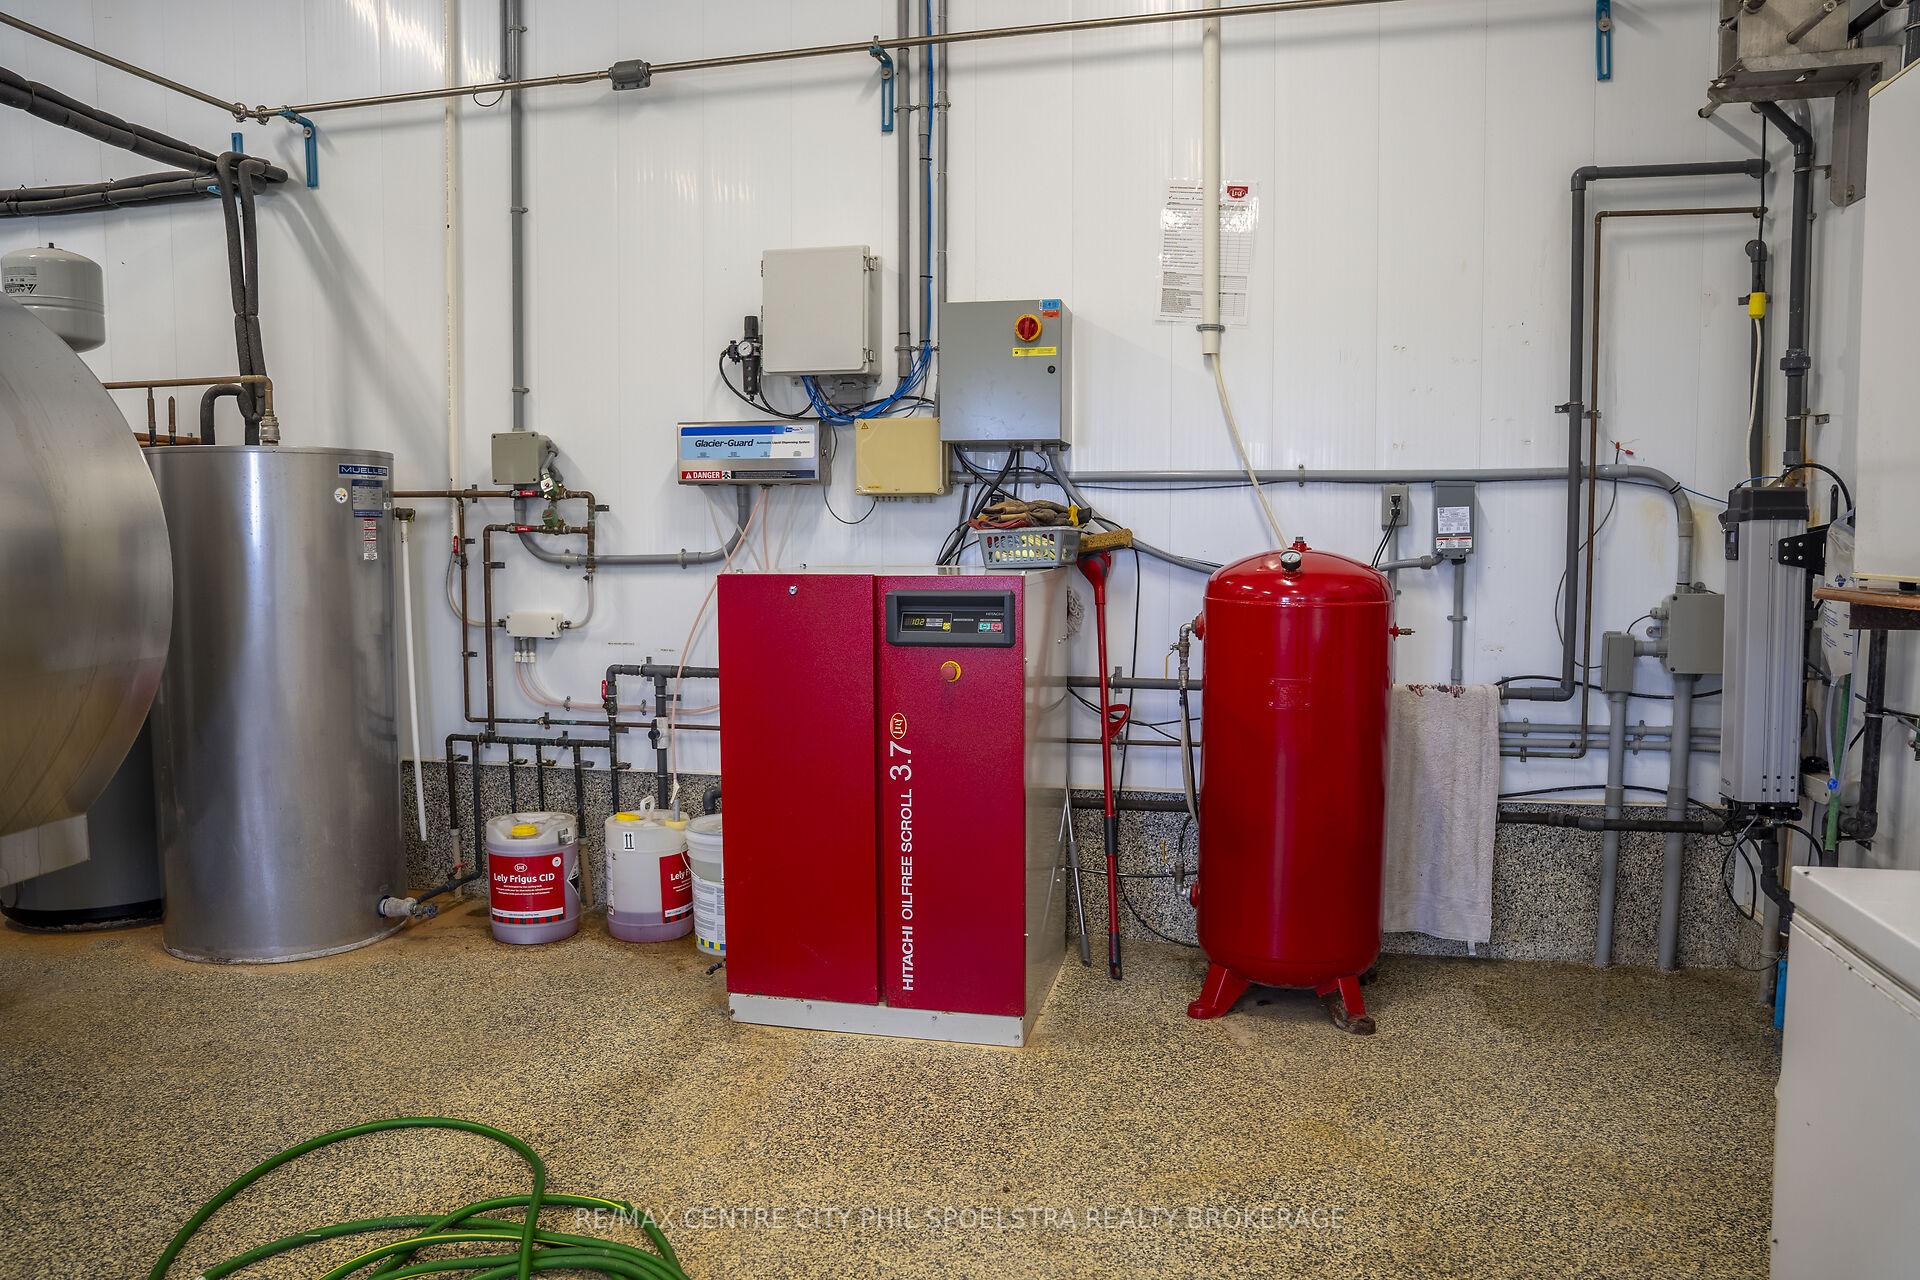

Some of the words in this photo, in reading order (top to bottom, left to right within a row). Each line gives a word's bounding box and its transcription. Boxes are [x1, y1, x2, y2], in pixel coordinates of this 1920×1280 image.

[695, 439, 754, 448] Glacier-Guard
[341, 466, 387, 475] MUELLER
[693, 471, 720, 479] DANGER
[889, 740, 912, 782] 3.7
[900, 788, 913, 853] SCROLL
[493, 873, 508, 884] Lely
[510, 874, 537, 885] Frigus
[539, 873, 555, 882] CID
[670, 870, 685, 881] Lely
[901, 856, 914, 920] OILFREE
[902, 925, 914, 991] HITACHI
